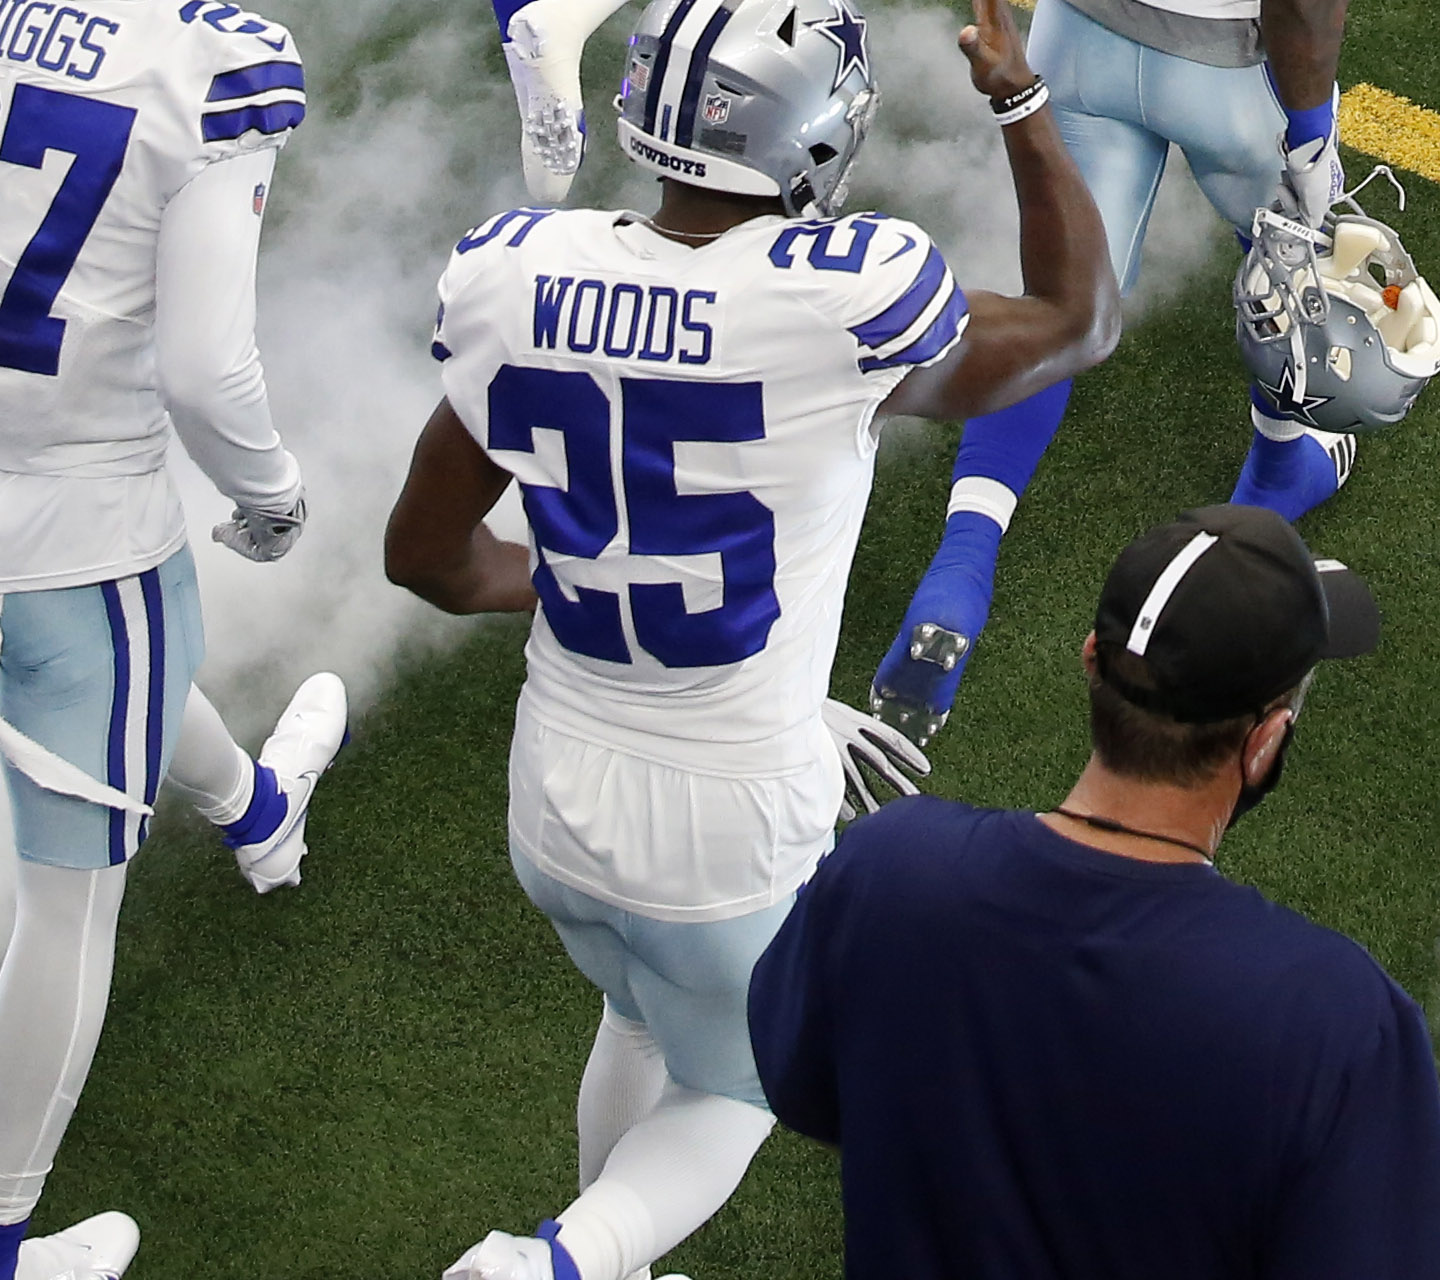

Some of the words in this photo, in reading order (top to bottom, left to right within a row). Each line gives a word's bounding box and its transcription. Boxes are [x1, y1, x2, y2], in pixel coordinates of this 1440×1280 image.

[628, 135, 708, 179] COWBOYS
[532, 274, 718, 366] WOODS
[487, 364, 783, 670] 25
